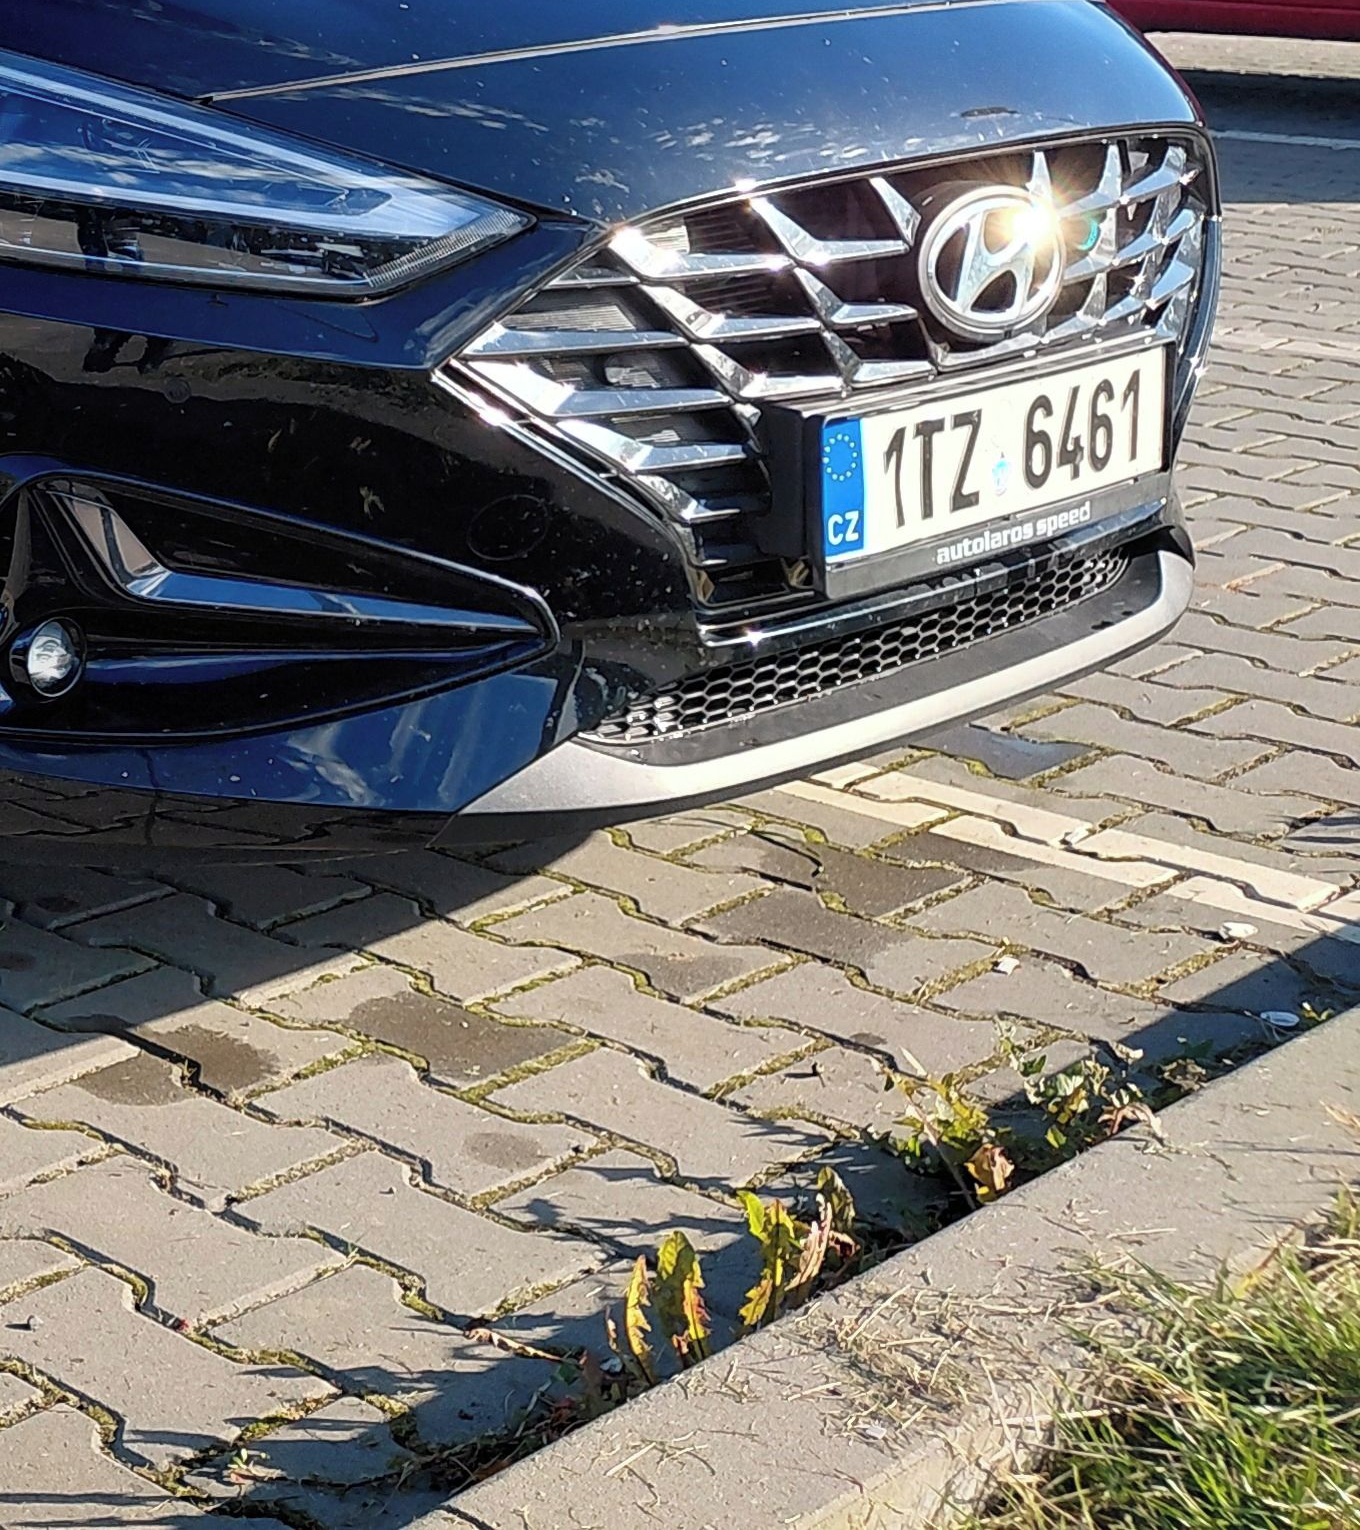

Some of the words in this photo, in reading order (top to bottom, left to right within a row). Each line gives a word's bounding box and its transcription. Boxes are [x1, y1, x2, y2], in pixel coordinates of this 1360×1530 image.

[882, 408, 983, 529] 1TZ
[1023, 369, 1141, 489] 6461
[827, 510, 859, 546] CZ
[936, 519, 1034, 564] autolaros
[1035, 501, 1092, 537] speed
